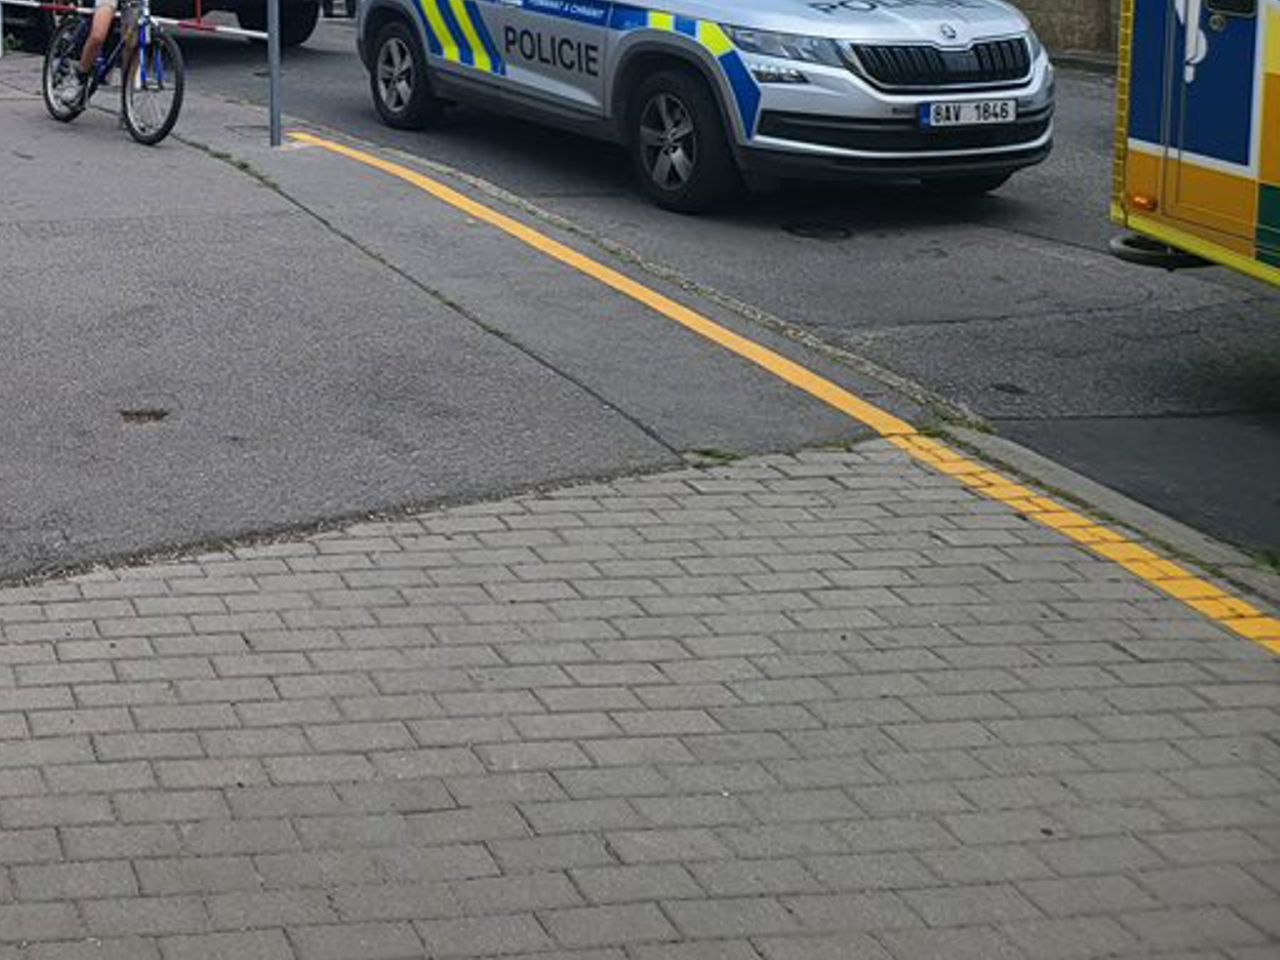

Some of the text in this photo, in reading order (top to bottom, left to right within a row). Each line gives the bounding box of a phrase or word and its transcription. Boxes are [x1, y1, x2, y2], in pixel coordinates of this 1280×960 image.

[504, 25, 600, 77] POLICIE
[933, 102, 1009, 123] 8AV 1846
